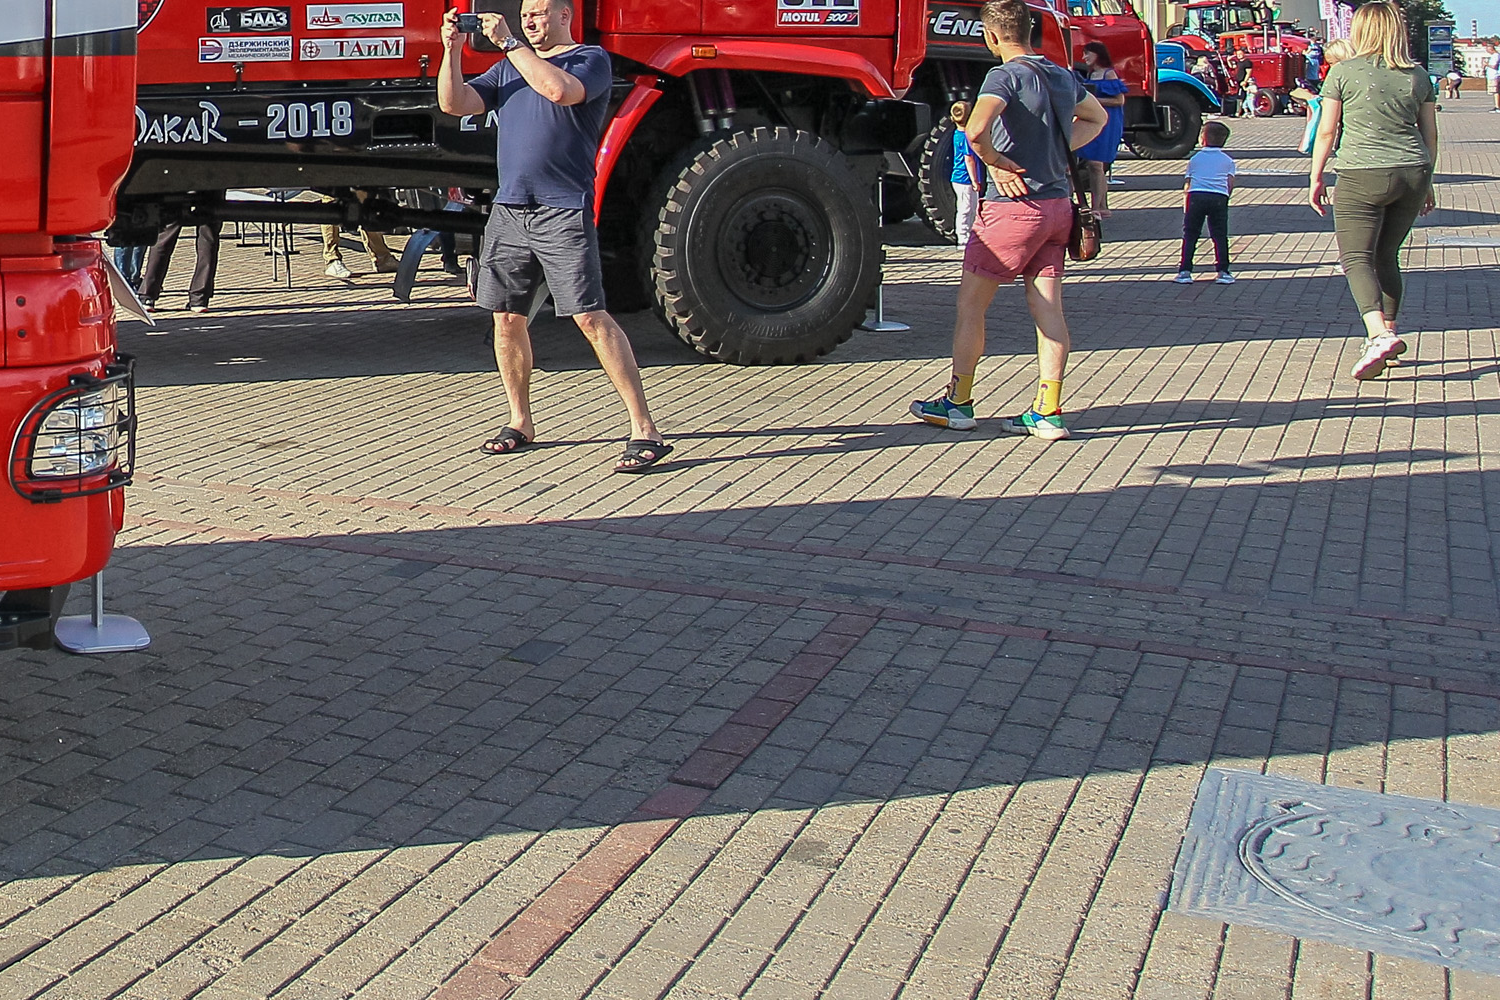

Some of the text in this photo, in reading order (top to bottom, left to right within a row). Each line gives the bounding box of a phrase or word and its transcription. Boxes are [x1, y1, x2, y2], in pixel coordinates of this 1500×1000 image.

[240, 12, 288, 28] БААЗ
[781, 12, 859, 23] MOTUL 300V
[228, 39, 290, 48] ДЗЕРЖИНСКИЙ
[333, 39, 401, 57] ТАиМ
[266, 101, 353, 140] 2018
